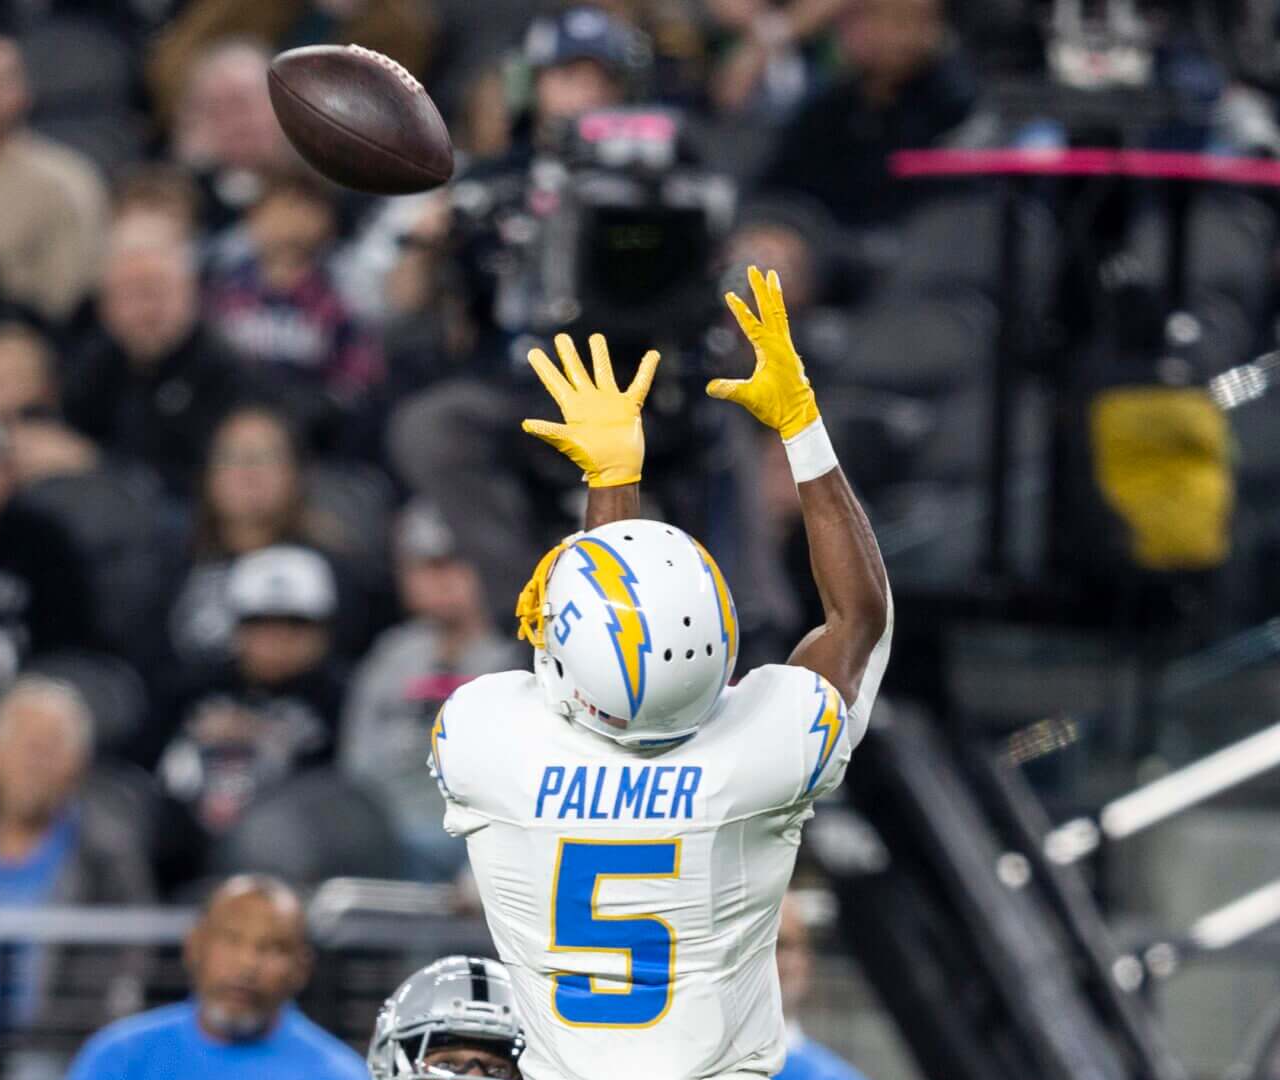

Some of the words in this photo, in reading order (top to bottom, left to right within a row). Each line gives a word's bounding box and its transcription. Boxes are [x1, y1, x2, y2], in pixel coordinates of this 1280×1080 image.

[554, 600, 582, 646] 5
[535, 766, 703, 819] PALMER
[548, 837, 682, 1029] 5
